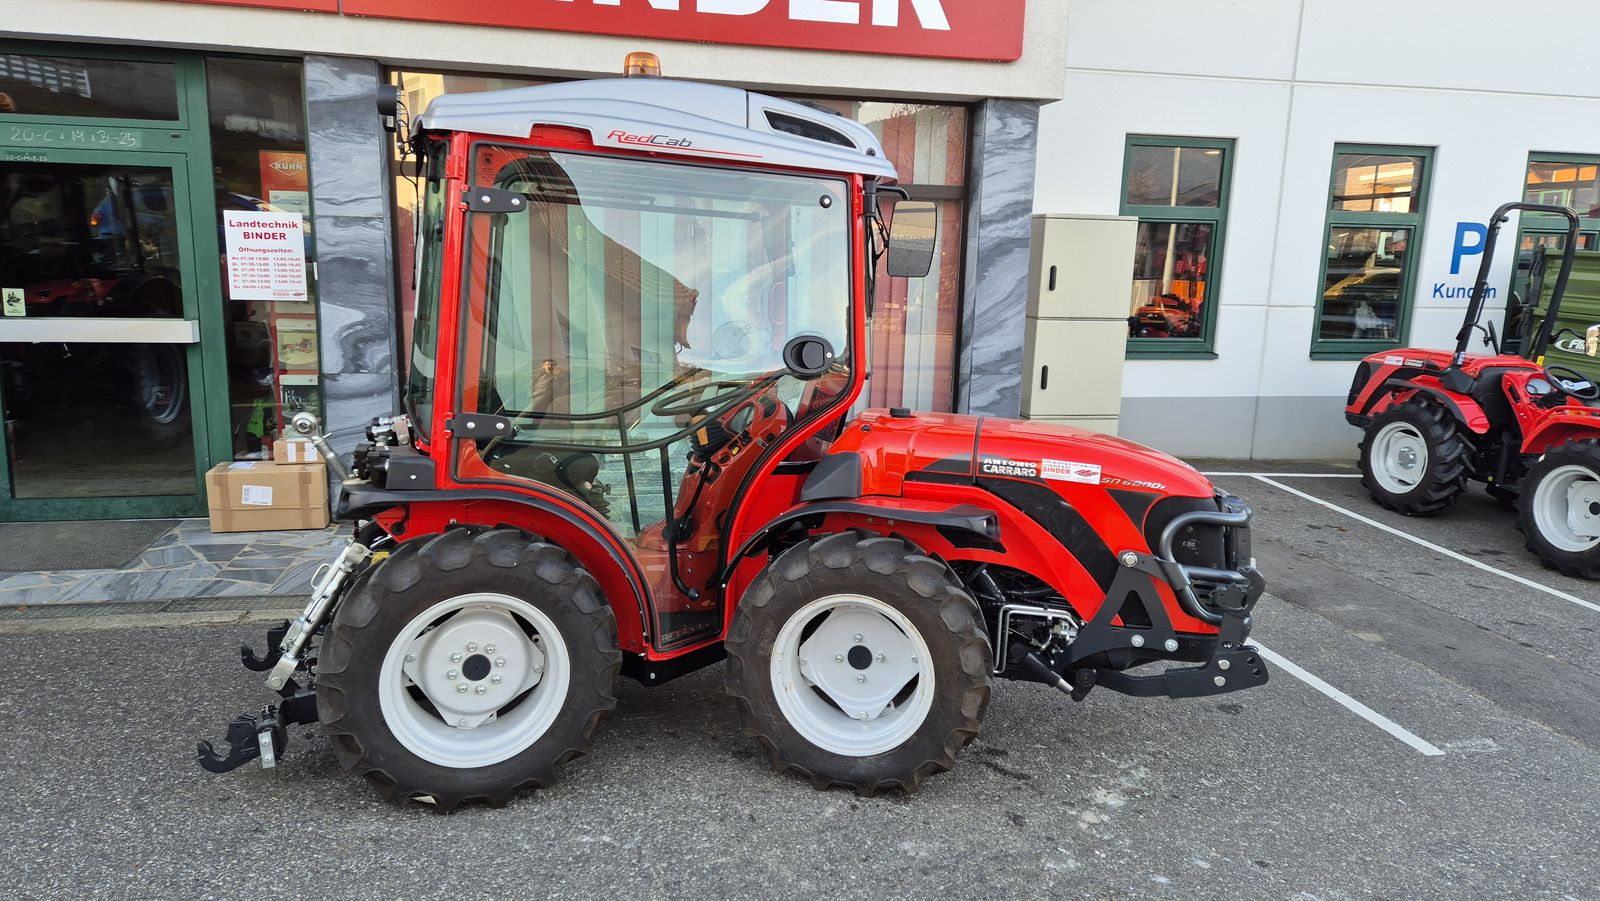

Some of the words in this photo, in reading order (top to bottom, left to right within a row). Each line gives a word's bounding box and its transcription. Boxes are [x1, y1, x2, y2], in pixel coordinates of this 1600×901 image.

[606, 130, 693, 147] RedCab
[274, 161, 303, 170] KUHN
[229, 219, 299, 229] Landtechnik
[243, 231, 287, 240] BINDER
[238, 246, 294, 255] Öffnungszeiten:
[1450, 222, 1489, 274] P
[983, 458, 1038, 468] ANTONIO
[983, 464, 1038, 477] CARRARO
